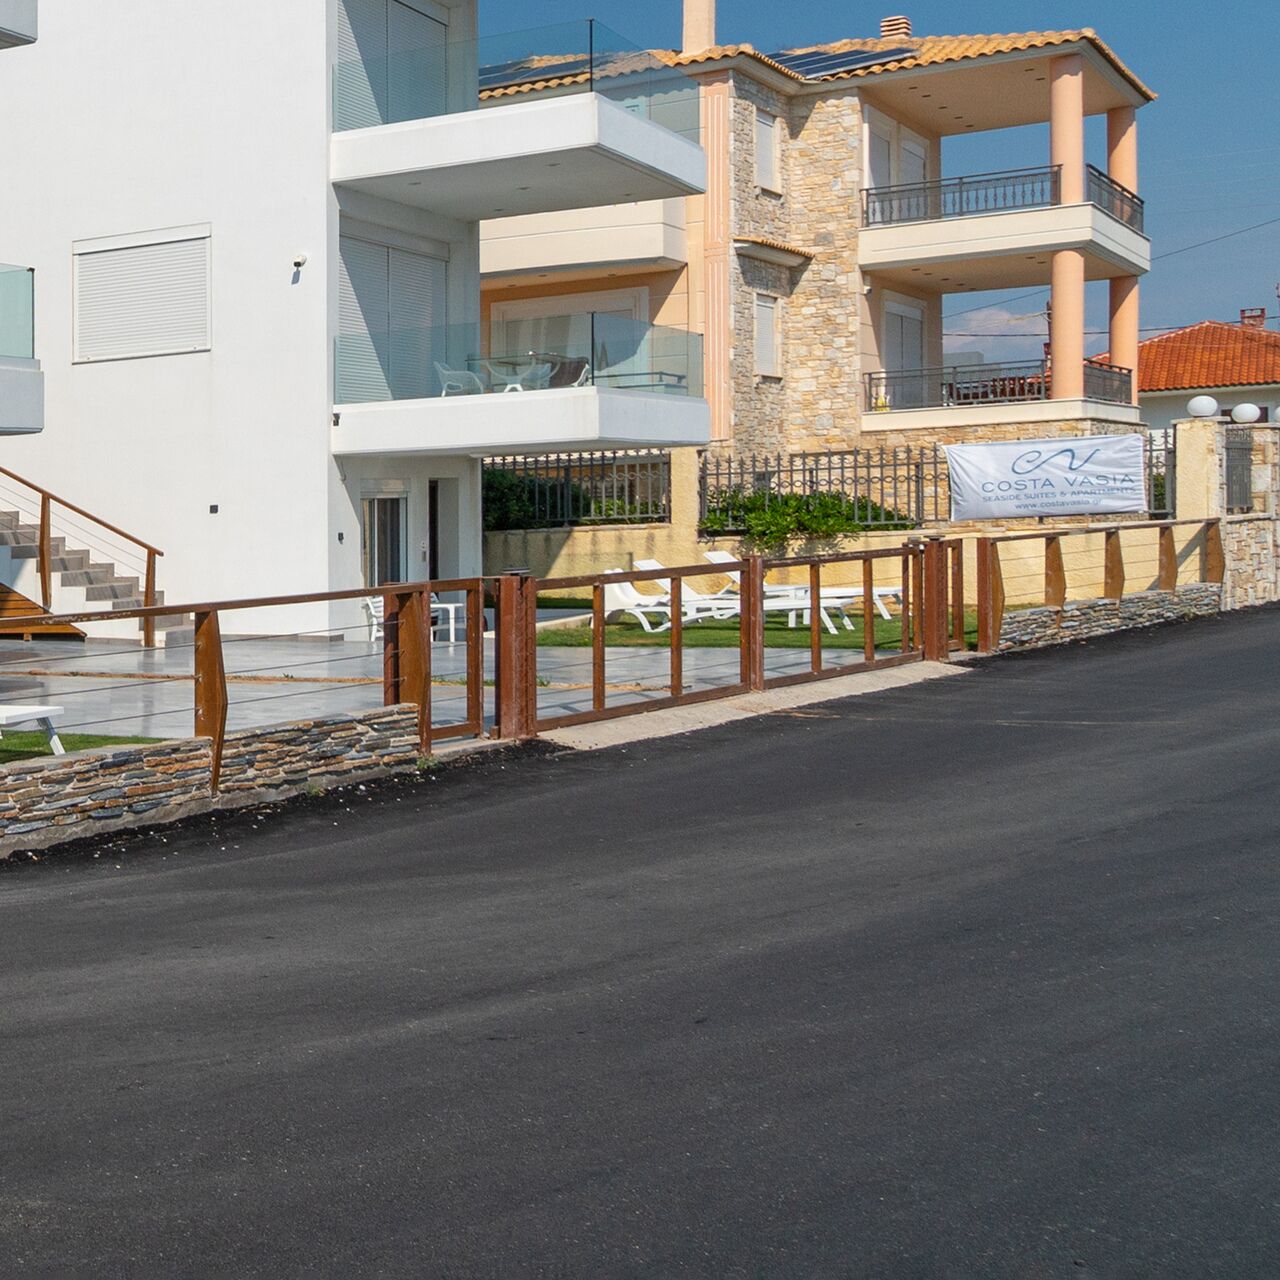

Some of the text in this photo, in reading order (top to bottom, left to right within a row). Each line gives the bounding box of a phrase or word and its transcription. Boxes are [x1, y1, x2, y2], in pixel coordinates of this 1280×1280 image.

[981, 474, 1135, 493] COSTA VASIA
[982, 494, 1022, 502] SEASIDE
[1070, 487, 1137, 496] APARTMENTS
[1015, 499, 1101, 510] www.costavasia.gr
